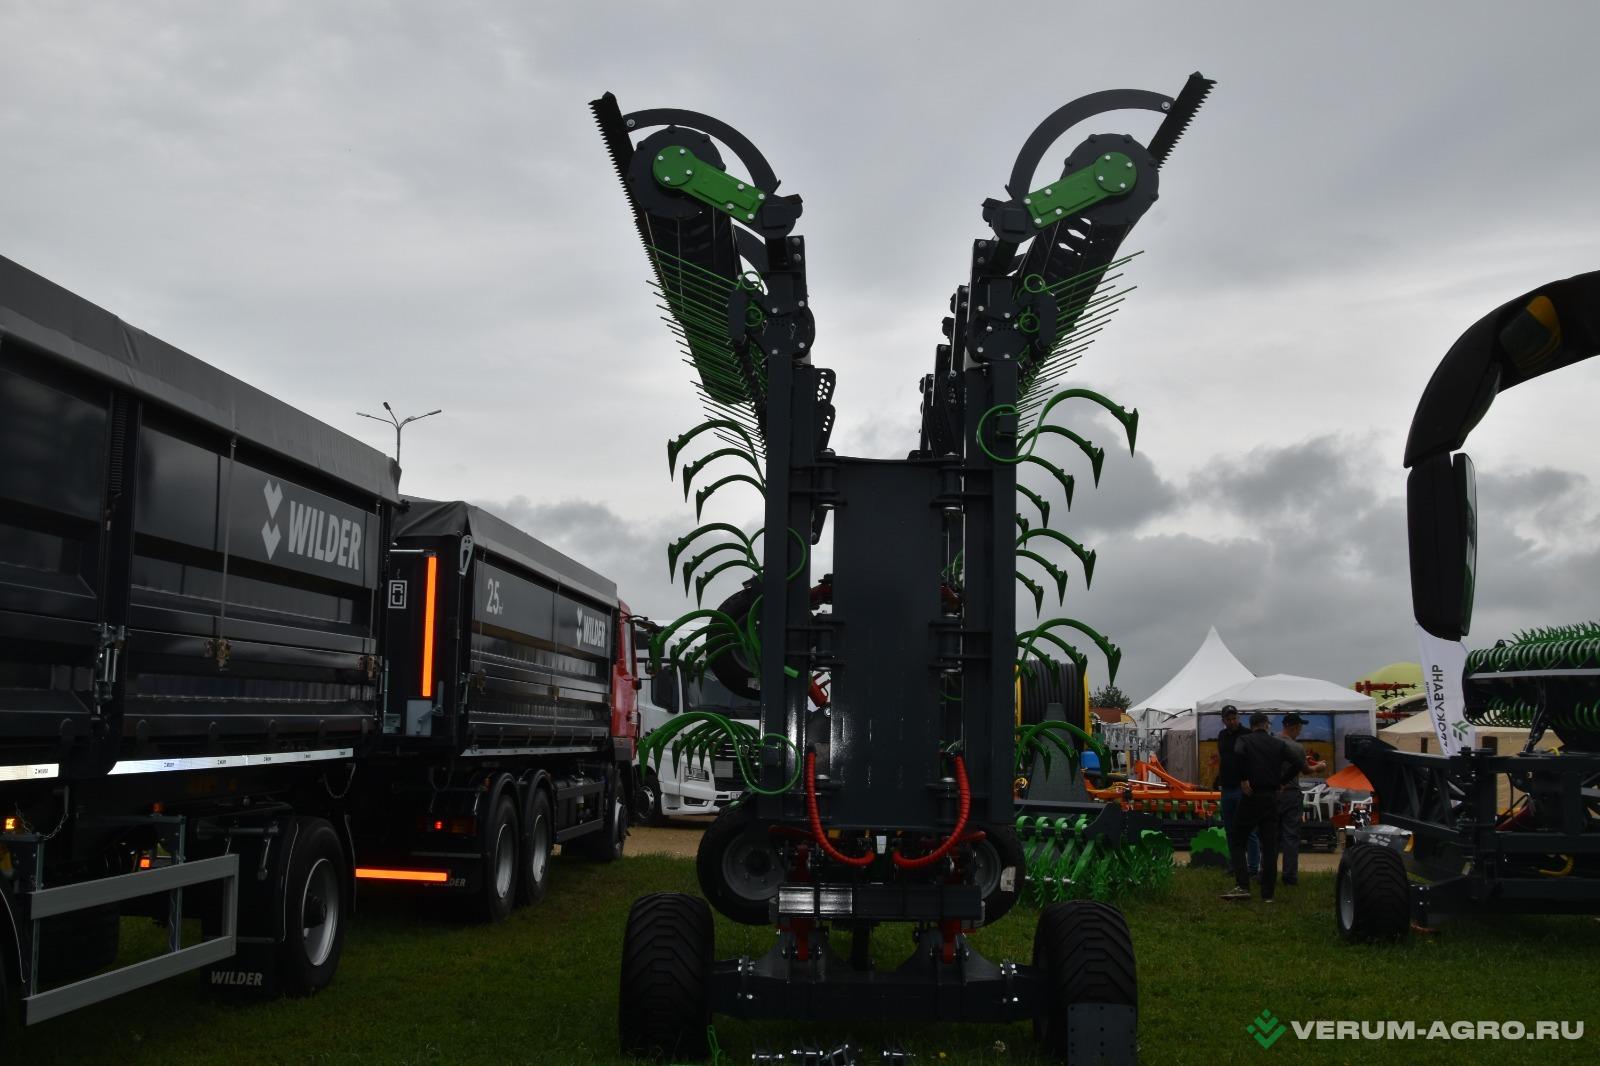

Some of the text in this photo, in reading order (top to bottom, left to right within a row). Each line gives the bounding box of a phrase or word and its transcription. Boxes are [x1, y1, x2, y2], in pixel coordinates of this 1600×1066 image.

[288, 500, 362, 571] WILDER
[486, 578, 500, 616] 25
[583, 614, 606, 649] WILDER
[210, 970, 264, 986] WILDER
